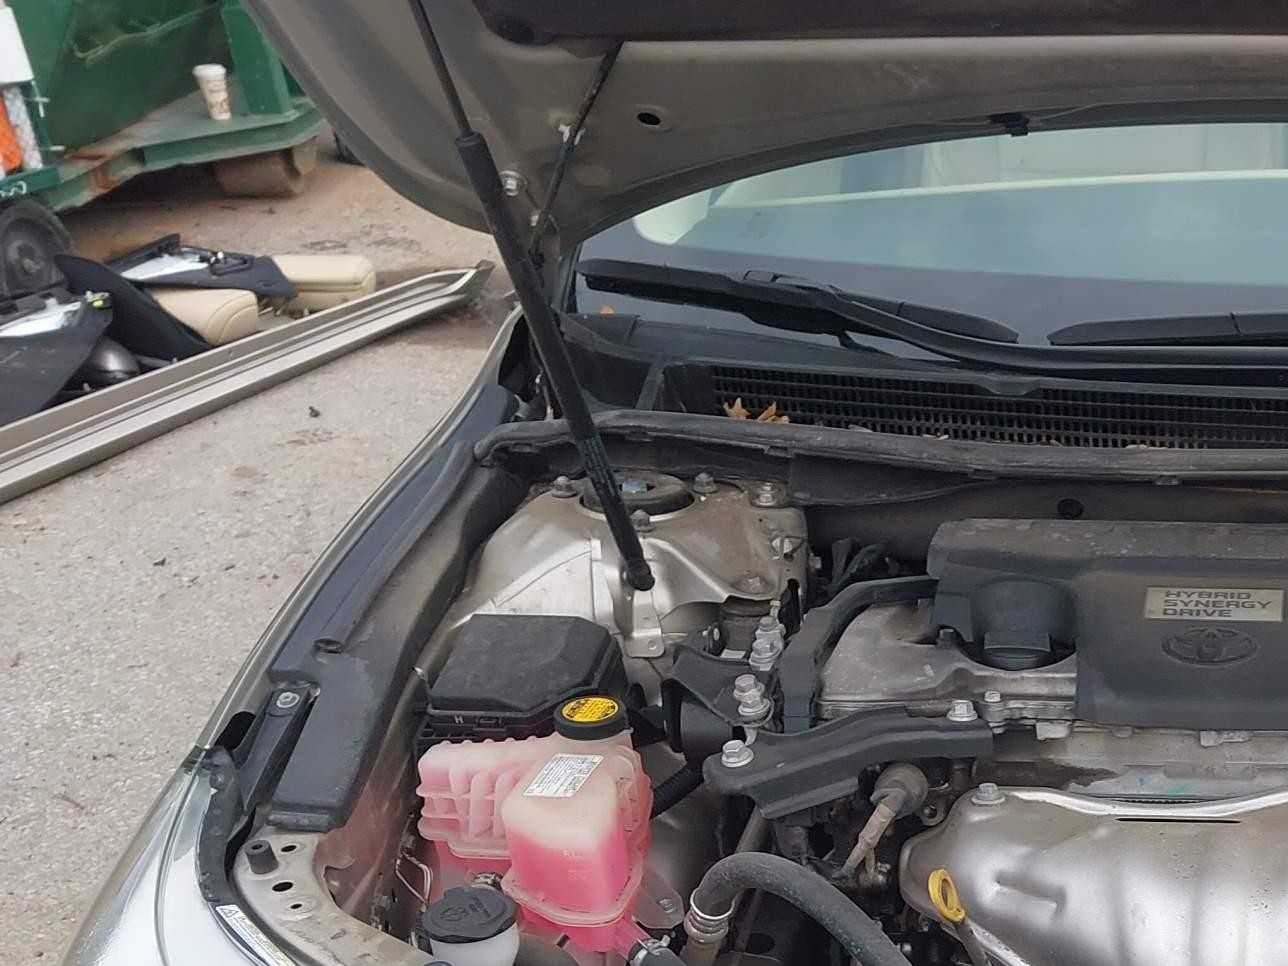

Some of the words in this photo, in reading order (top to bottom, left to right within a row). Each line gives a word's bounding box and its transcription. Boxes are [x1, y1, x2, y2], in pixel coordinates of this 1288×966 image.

[1165, 590, 1251, 600] HYBRID
[1163, 599, 1272, 609] SYNERGY
[1162, 608, 1233, 618] DRIVE
